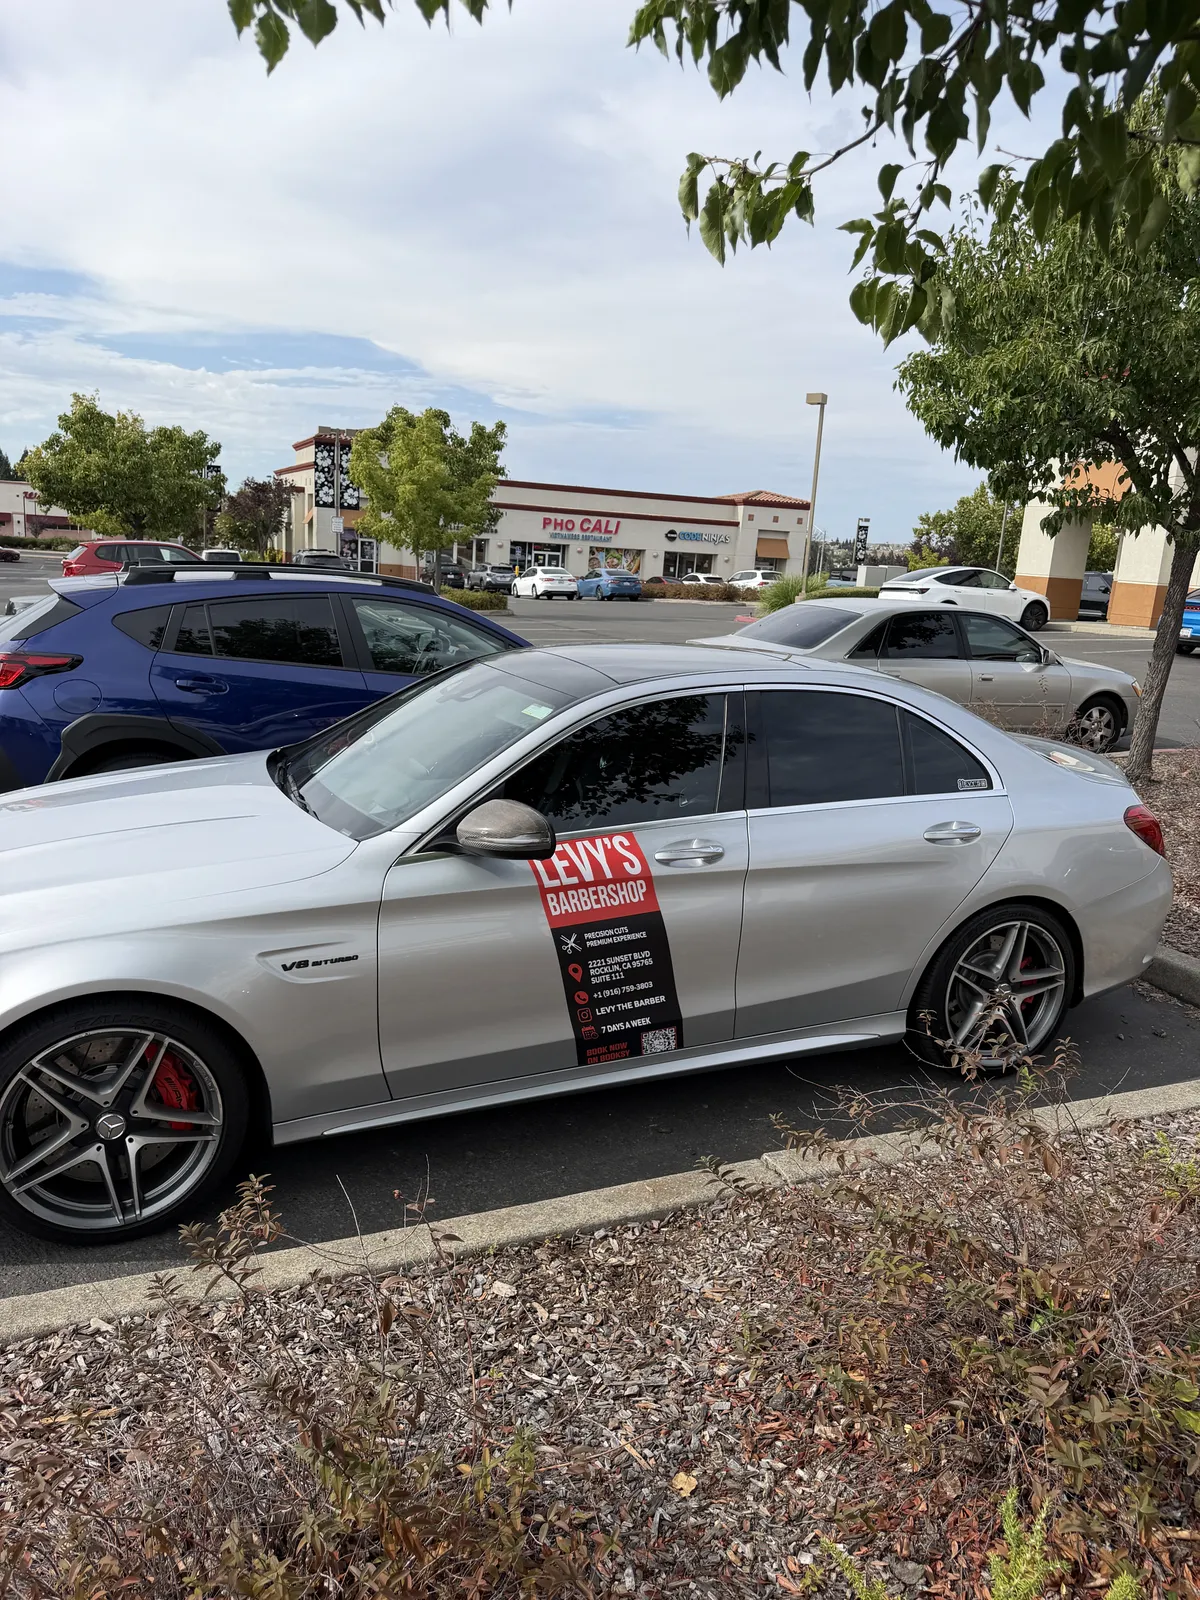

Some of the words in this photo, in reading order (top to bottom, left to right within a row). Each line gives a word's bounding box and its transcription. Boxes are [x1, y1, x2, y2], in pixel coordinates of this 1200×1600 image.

[542, 516, 576, 532] PHO
[580, 517, 622, 535] CALI
[533, 835, 642, 888] LEVY'S
[546, 879, 647, 916] BARBERSHOP
[584, 928, 614, 940] PRECISION
[614, 926, 629, 935] CUTS
[586, 937, 613, 948] PREMIUM
[613, 931, 647, 943] EXPERIENCE
[281, 959, 309, 972] V8
[311, 954, 359, 967] BITURBO
[588, 959, 606, 968] 2221
[606, 953, 632, 965] SUNSET
[633, 950, 651, 960] BLVD
[590, 964, 622, 976] ROCKLIN,
[622, 962, 632, 970] CA
[632, 958, 654, 968] 95765
[591, 974, 611, 984] SUITE
[611, 972, 625, 980] 111
[593, 991, 602, 999] +1
[603, 987, 621, 998] (916)
[621, 981, 653, 993] 759-3803
[595, 1005, 616, 1016] LEVY
[616, 1001, 634, 1011] THE
[634, 995, 666, 1008] BARBER
[601, 1026, 606, 1034] 7
[606, 1022, 625, 1033] DAYS
[625, 1021, 631, 1029] A
[630, 1017, 652, 1028] WEEK
[586, 1045, 608, 1057] BOOK
[609, 1041, 628, 1052] NOW
[587, 1056, 599, 1065] ON
[600, 1049, 630, 1062] BOOKSY
